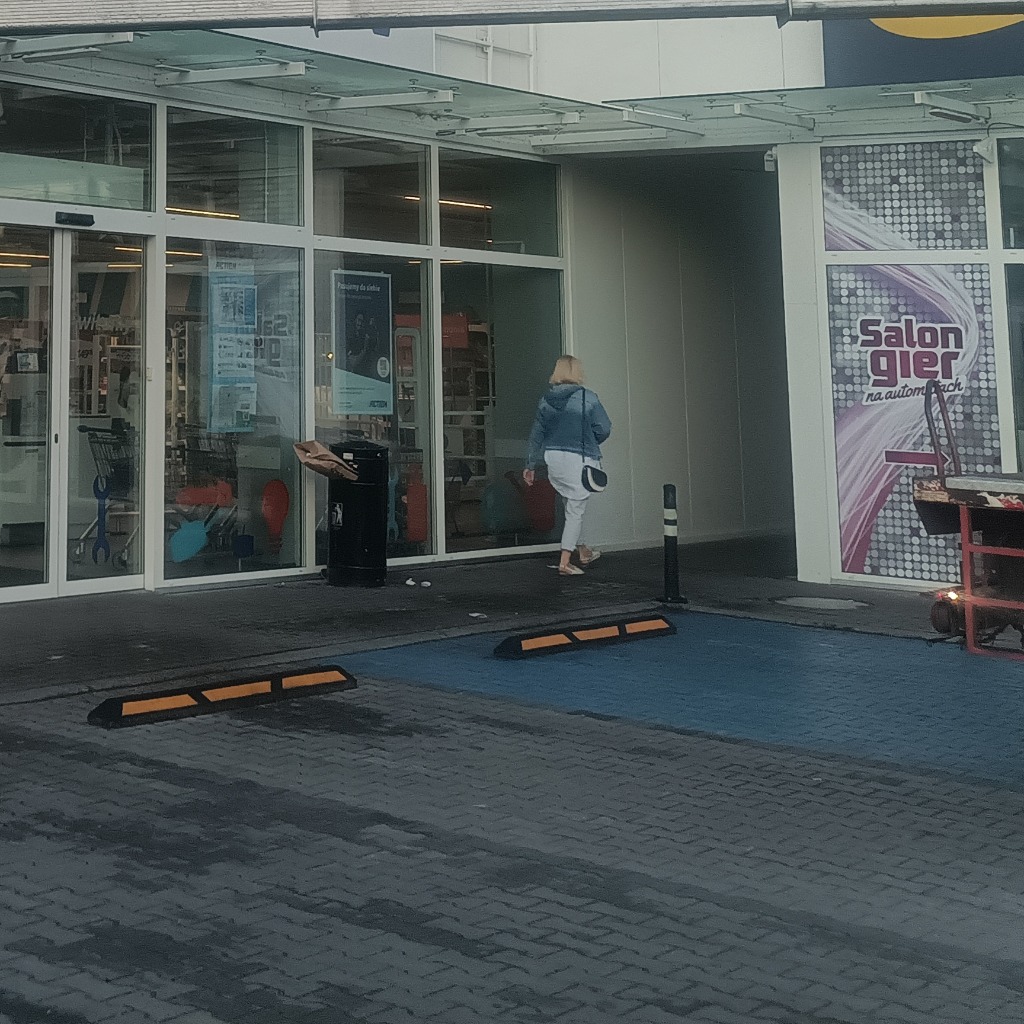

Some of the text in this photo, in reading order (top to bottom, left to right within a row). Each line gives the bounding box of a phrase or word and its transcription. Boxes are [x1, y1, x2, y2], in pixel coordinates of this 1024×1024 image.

[859, 318, 964, 349] Salon
[870, 349, 961, 388] gier
[865, 377, 964, 403] na automach
